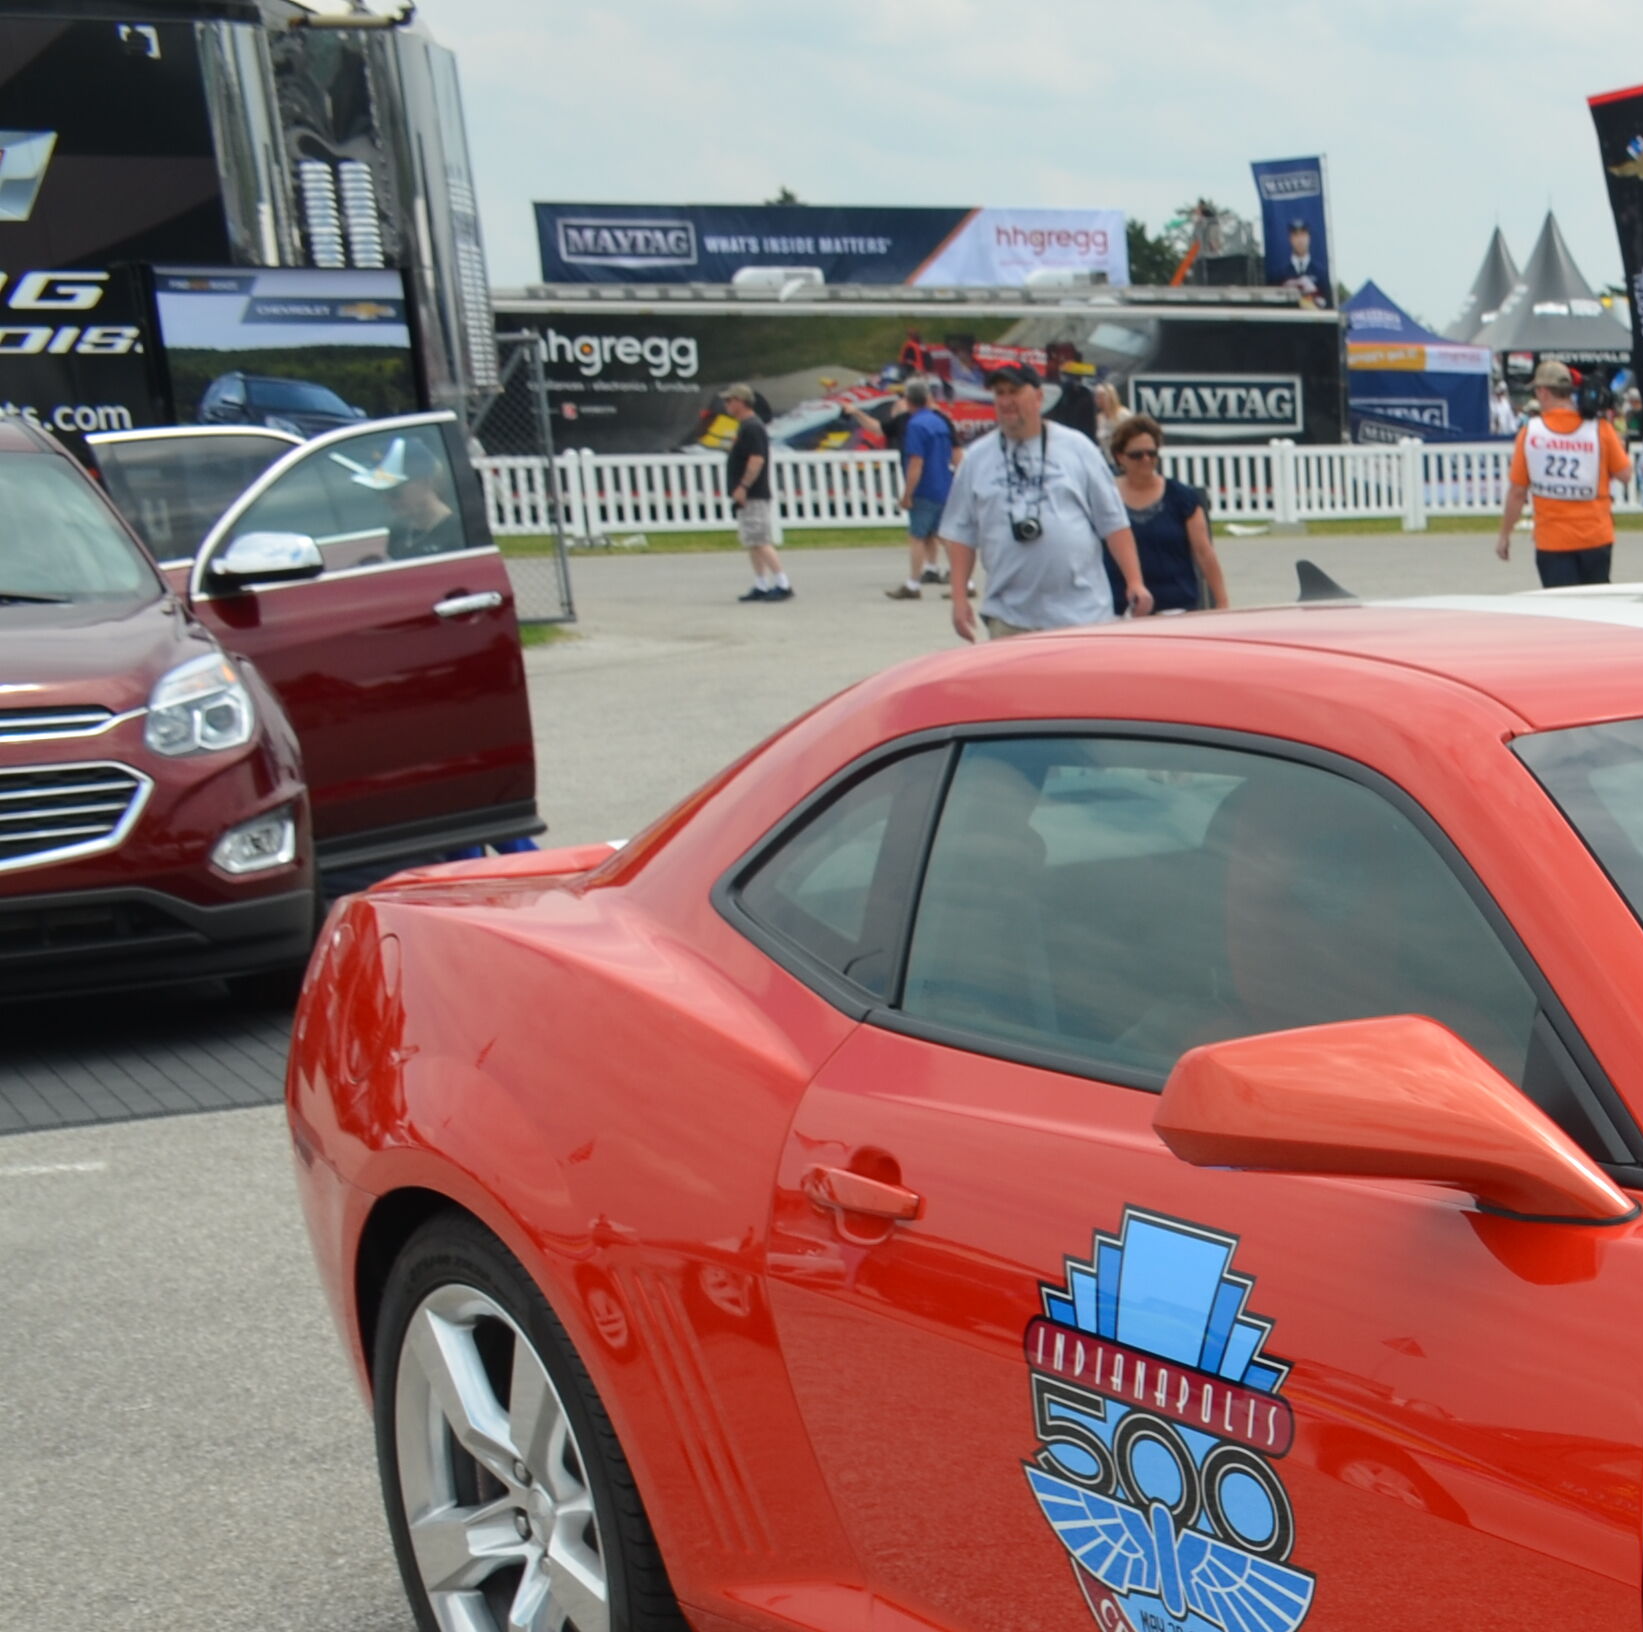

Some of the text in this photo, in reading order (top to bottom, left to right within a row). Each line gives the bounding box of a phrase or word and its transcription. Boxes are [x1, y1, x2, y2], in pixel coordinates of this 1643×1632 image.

[566, 227, 690, 255] MAYTAG
[704, 236, 760, 254] WHAT'S
[763, 236, 815, 254] INSIDE
[996, 225, 1108, 256] hhgregg
[1138, 387, 1295, 419] MAYTAG
[1530, 436, 1594, 453] Canon
[1545, 454, 1580, 479] 222
[1037, 1326, 1278, 1446] INDIANAPOLIS
[1032, 1372, 1295, 1561] 500
